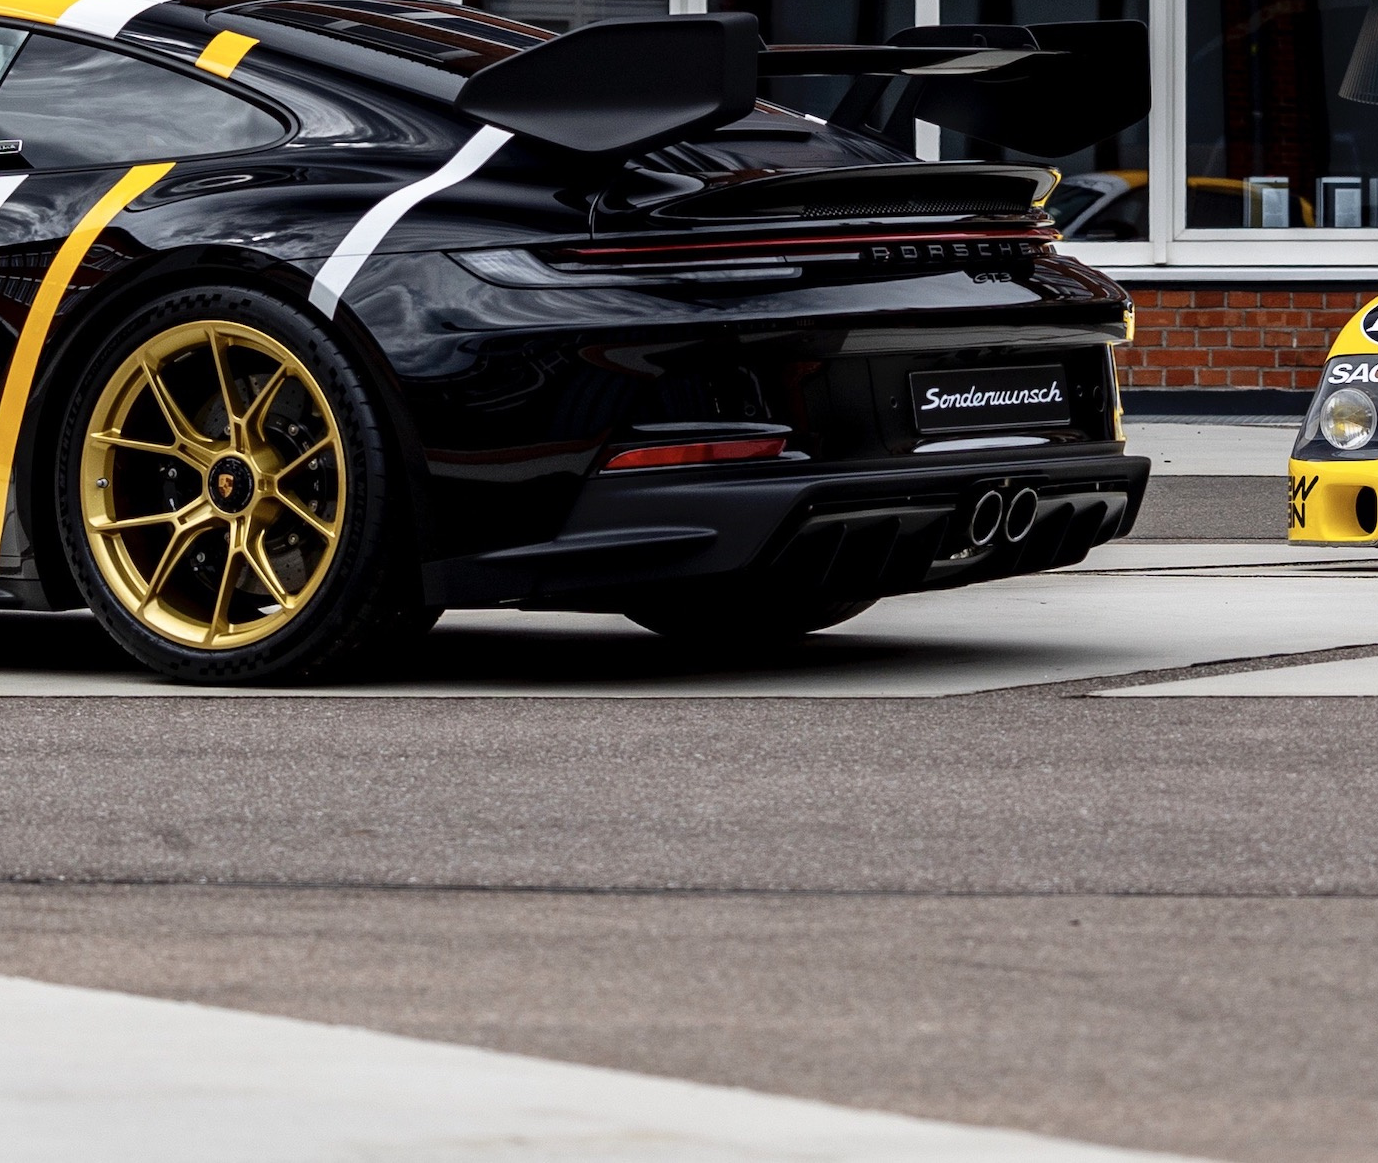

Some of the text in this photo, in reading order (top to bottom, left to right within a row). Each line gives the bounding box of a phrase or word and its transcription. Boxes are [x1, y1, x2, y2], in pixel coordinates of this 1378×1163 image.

[871, 242, 1030, 260] PORSCHE
[974, 272, 1013, 283] GT3
[921, 380, 1063, 410] Sonderwunsch
